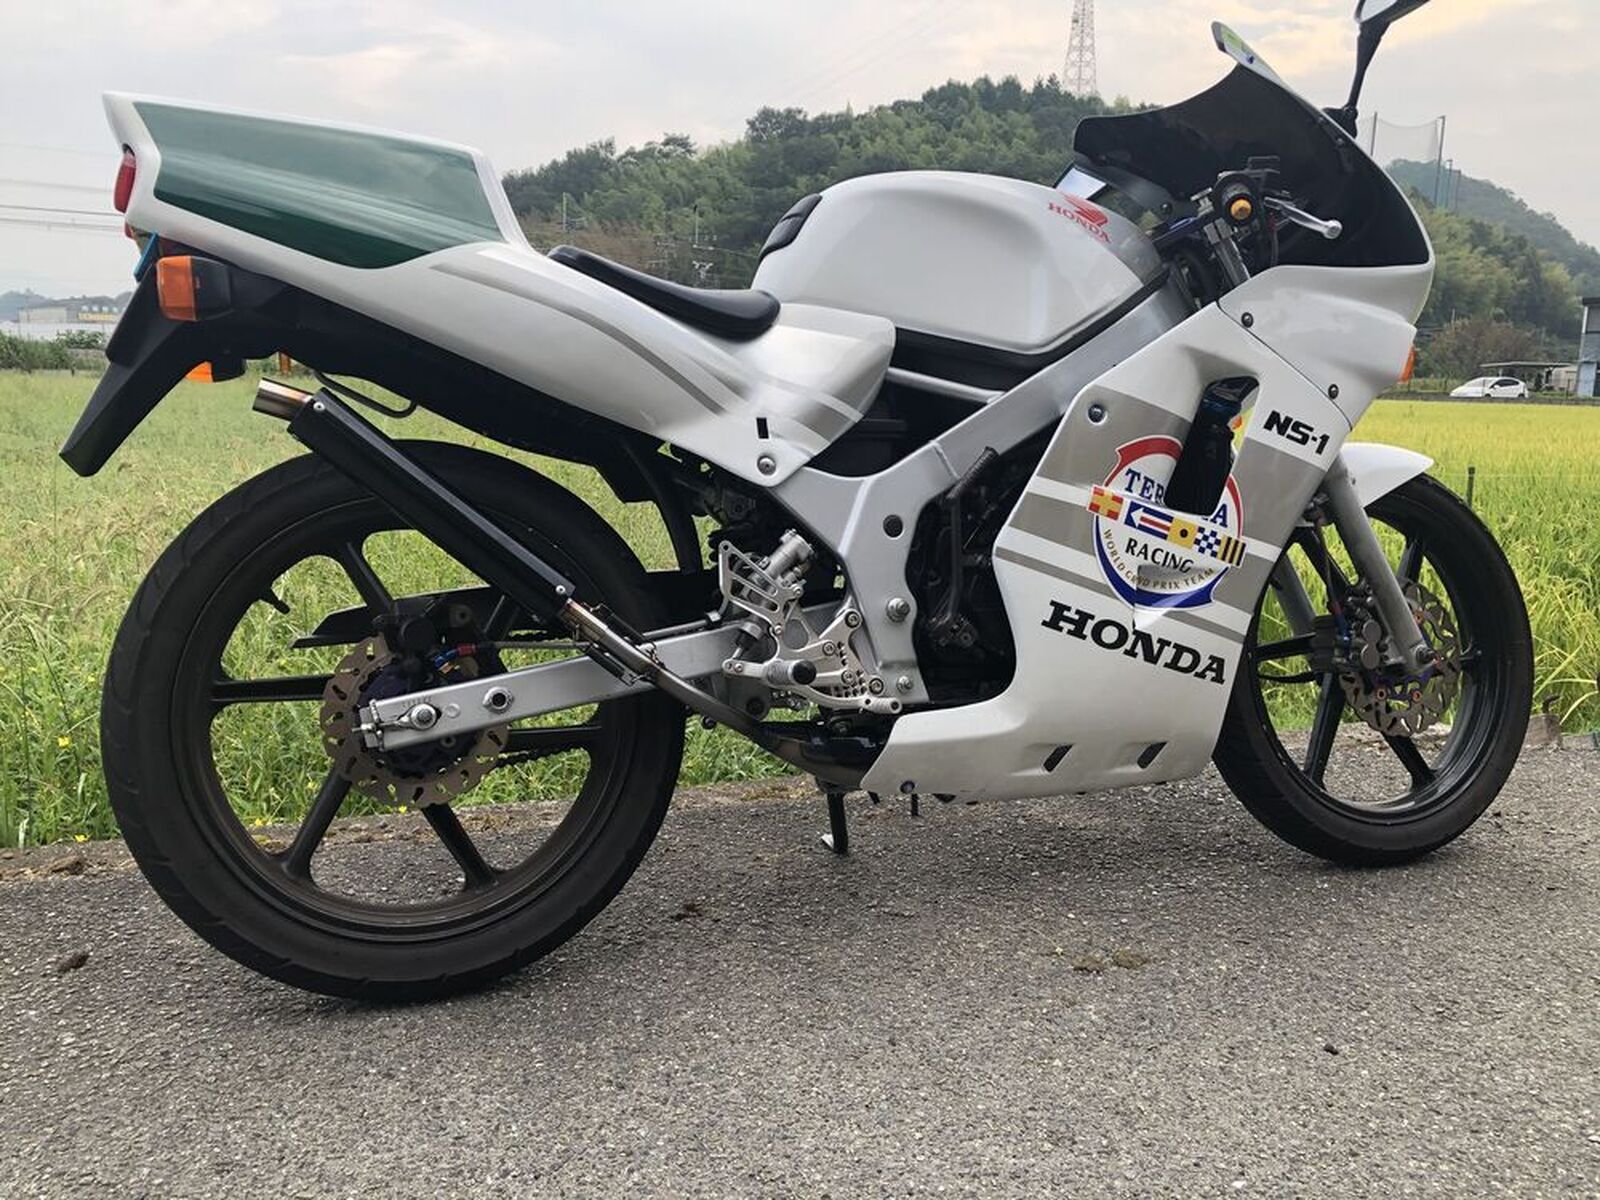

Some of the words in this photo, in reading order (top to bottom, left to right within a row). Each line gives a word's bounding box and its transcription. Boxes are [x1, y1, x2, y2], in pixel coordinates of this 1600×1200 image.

[1048, 201, 1112, 244] HONDA
[1263, 409, 1330, 456] NS-1
[1103, 528, 1126, 570] WORLD
[1152, 579, 1181, 590] PRIX
[1183, 567, 1215, 587] TEAM
[1125, 537, 1194, 574] RACING
[1041, 599, 1226, 686] HONDA
